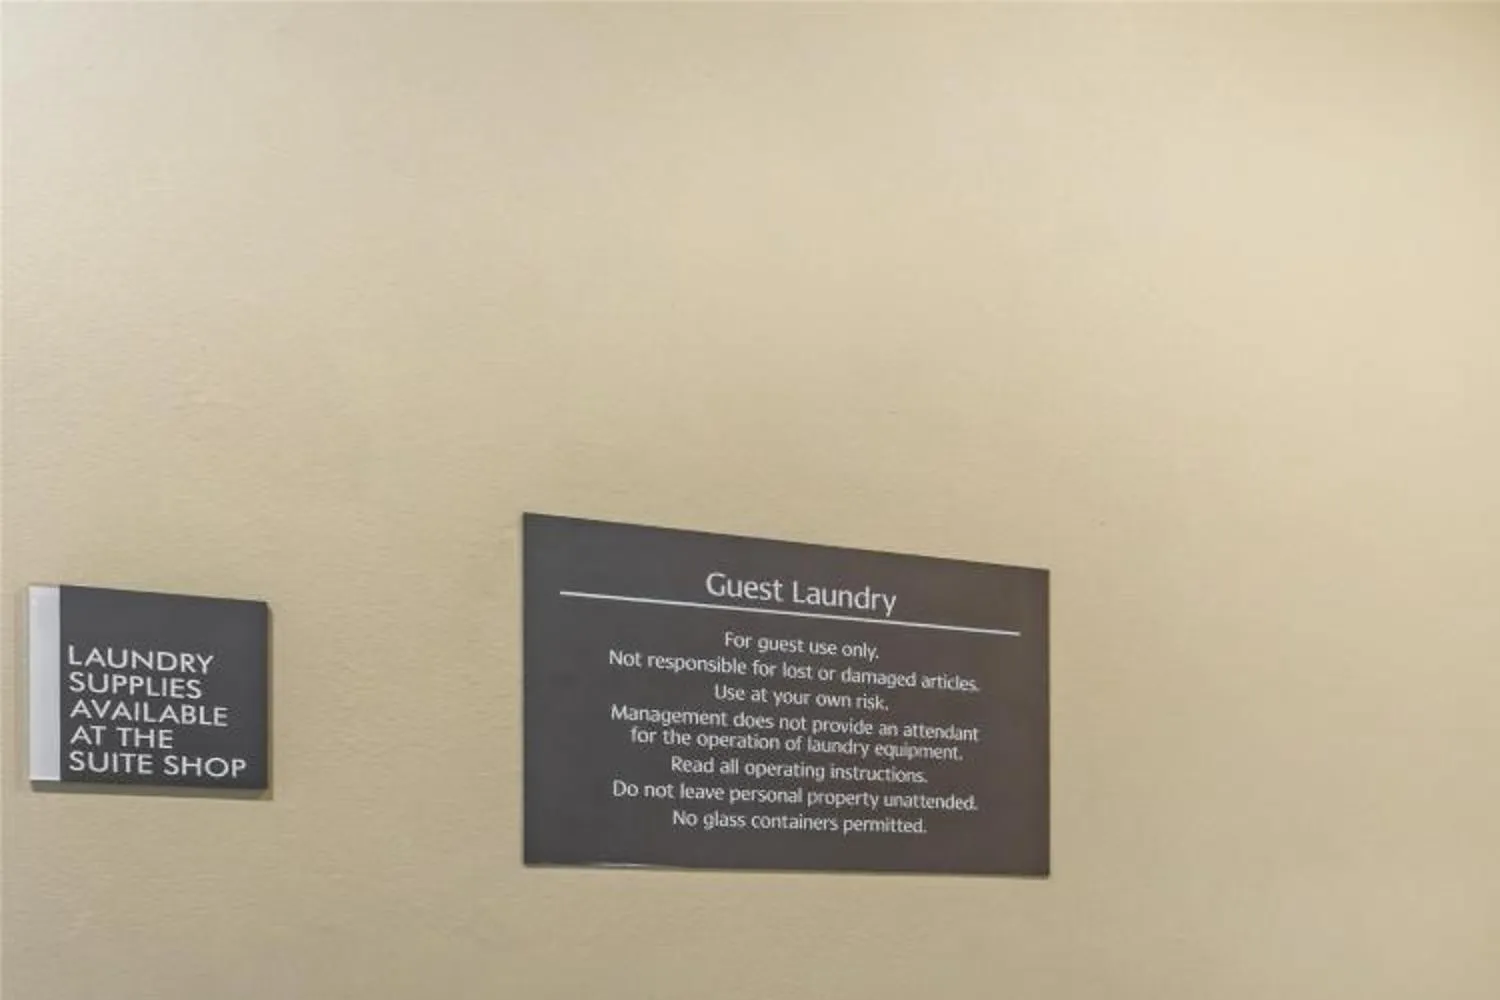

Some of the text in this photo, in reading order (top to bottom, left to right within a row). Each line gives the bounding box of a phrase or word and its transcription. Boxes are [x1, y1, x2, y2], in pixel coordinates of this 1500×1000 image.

[706, 571, 897, 617] Guest Laundry
[68, 645, 214, 675] LAUNDRY
[725, 631, 879, 662] For guest use only.
[68, 671, 202, 699] SUPPLIES
[609, 650, 980, 692] Not responsible for lost or damaged articles.
[715, 684, 889, 711] Use at your own risk.
[70, 699, 229, 727] AVAILABLE
[611, 704, 980, 741] Management does not provide an attendant
[70, 725, 173, 749] AT THE
[630, 725, 963, 760] for the operation of laundry equipment.
[68, 751, 247, 778] SUITE SHOP
[671, 756, 928, 783] Read all operating instructions.
[612, 780, 978, 811] Do not leave personal property unattended.
[673, 810, 927, 835] No glass containers permitted.
